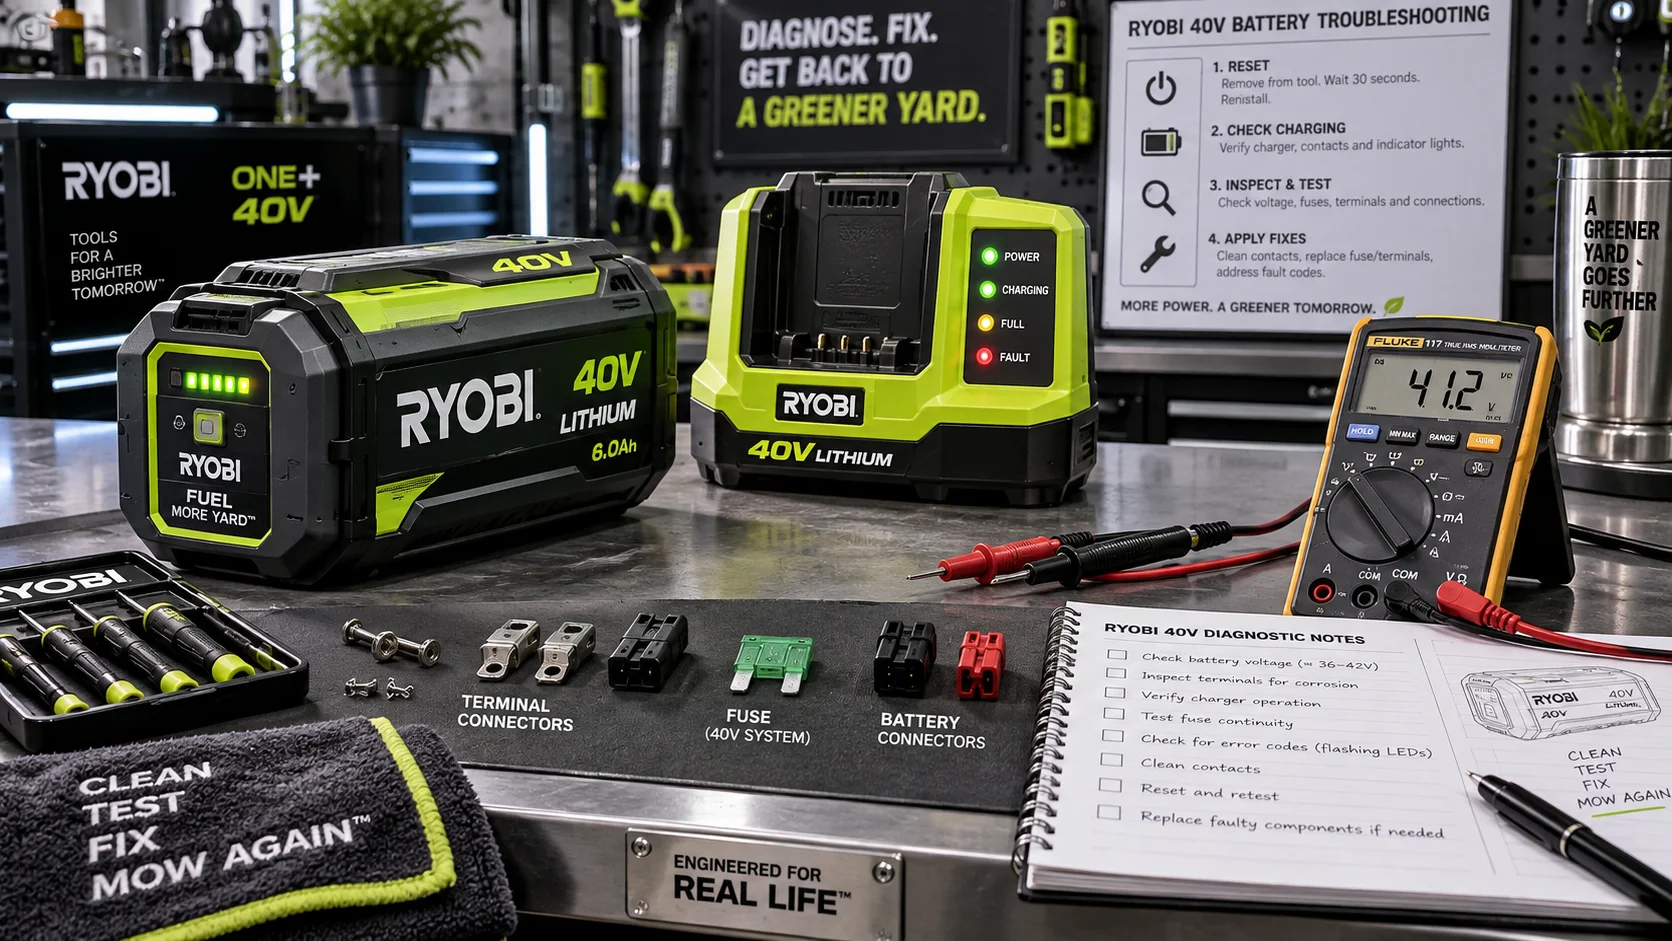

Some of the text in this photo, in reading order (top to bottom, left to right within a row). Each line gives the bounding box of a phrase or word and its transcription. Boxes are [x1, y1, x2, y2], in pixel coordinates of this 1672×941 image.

[1128, 5, 1490, 37] RYOBI 40V BATTERY TROUBLESHOOTING
[740, 12, 938, 51] DIAGNOSE. FIX.
[739, 52, 913, 89] GET BACK TO
[1213, 60, 1270, 73] 1. RESET
[1221, 72, 1420, 89] Remove from tool. Wait 30 seconds.
[736, 89, 986, 128] A GREENER YARD.
[1211, 122, 1346, 137] 2. CHECK CHARGING
[1219, 137, 1465, 155] Verify charger, contacts and indicator lights.
[62, 160, 321, 200] RYOBI ONE+
[1210, 178, 1331, 191] 3. INSPECT & TEST
[232, 196, 315, 225] 40V
[1218, 195, 1485, 210] Check voltage, fuses, terminals and connections.
[1585, 196, 1597, 216] A
[69, 231, 118, 246] TOOLS
[1208, 233, 1306, 245] 4. APPLY FIXES
[1584, 219, 1660, 241] GREENER
[71, 249, 114, 265] FOR A
[491, 250, 574, 274] 40V
[1004, 252, 1040, 262] POWER
[1217, 250, 1433, 264] Clean contacts, replace fuse/terminals,
[1583, 242, 1629, 264] YARD
[71, 264, 142, 283] BRIGHTER
[1216, 266, 1326, 278] address fault codes.
[1583, 266, 1630, 286] GOES
[1002, 285, 1049, 295] CHARGING
[1121, 301, 1376, 314] MORE POWER. A GREENER TOMORROW.
[1582, 289, 1657, 311] FURTHER
[1001, 319, 1025, 329] FULL
[1373, 337, 1420, 346] FLUKE
[1425, 340, 1442, 348] 117
[1000, 352, 1031, 362] FAULT
[573, 350, 643, 395] 40V
[1409, 369, 1484, 411] 41.2
[783, 391, 856, 418] RYOBI
[560, 399, 637, 435] LITHIUM
[1351, 427, 1374, 436] HOLD
[1429, 433, 1456, 443] RANGE
[591, 438, 637, 462] 6.0Ah
[748, 440, 893, 467] 40V LITHIUM
[179, 452, 241, 483] RYOBI
[186, 489, 233, 509] FUEL
[171, 505, 208, 521] MORE
[1443, 512, 1464, 524] mA
[1322, 563, 1332, 574] A
[1358, 571, 1381, 581] COM
[1392, 568, 1419, 581] COM
[1104, 623, 1366, 645] RYOBI 40V DIAGNOSTIC NOTES
[1142, 652, 1183, 664] Check
[1188, 655, 1239, 668] battery
[1245, 657, 1293, 669] voltage
[1142, 671, 1358, 690] Inspect terminals for corrosion
[462, 694, 551, 714] TERMINAL
[1141, 690, 1322, 709] Verify charger operation
[1532, 691, 1579, 706] RYOBI
[457, 712, 575, 732] CONNECTORS
[726, 708, 771, 725] FUSE
[880, 712, 961, 731] BATTERY
[1141, 711, 1294, 730] Test fuse continuity
[705, 726, 811, 746] (40V SYSTEM)
[877, 731, 986, 750] CONNECTORS
[1141, 734, 1433, 759] Check for error codes (flashing LEDs)
[1568, 747, 1622, 762] CLEAN
[1141, 757, 1261, 774] Clean contacts
[1574, 762, 1617, 776] TEST
[79, 761, 212, 796] CLEAN
[1582, 778, 1611, 791] FIX
[1141, 783, 1280, 802] Reset and retest
[1577, 788, 1671, 809] MOW AGAIN
[81, 790, 185, 827] TEST
[1141, 810, 1445, 839] Replace faulty components if needed
[88, 825, 161, 864] FIX
[91, 851, 207, 901] MOW
[674, 854, 821, 882] ENGINEERED FOR
[674, 874, 757, 907] REAL
